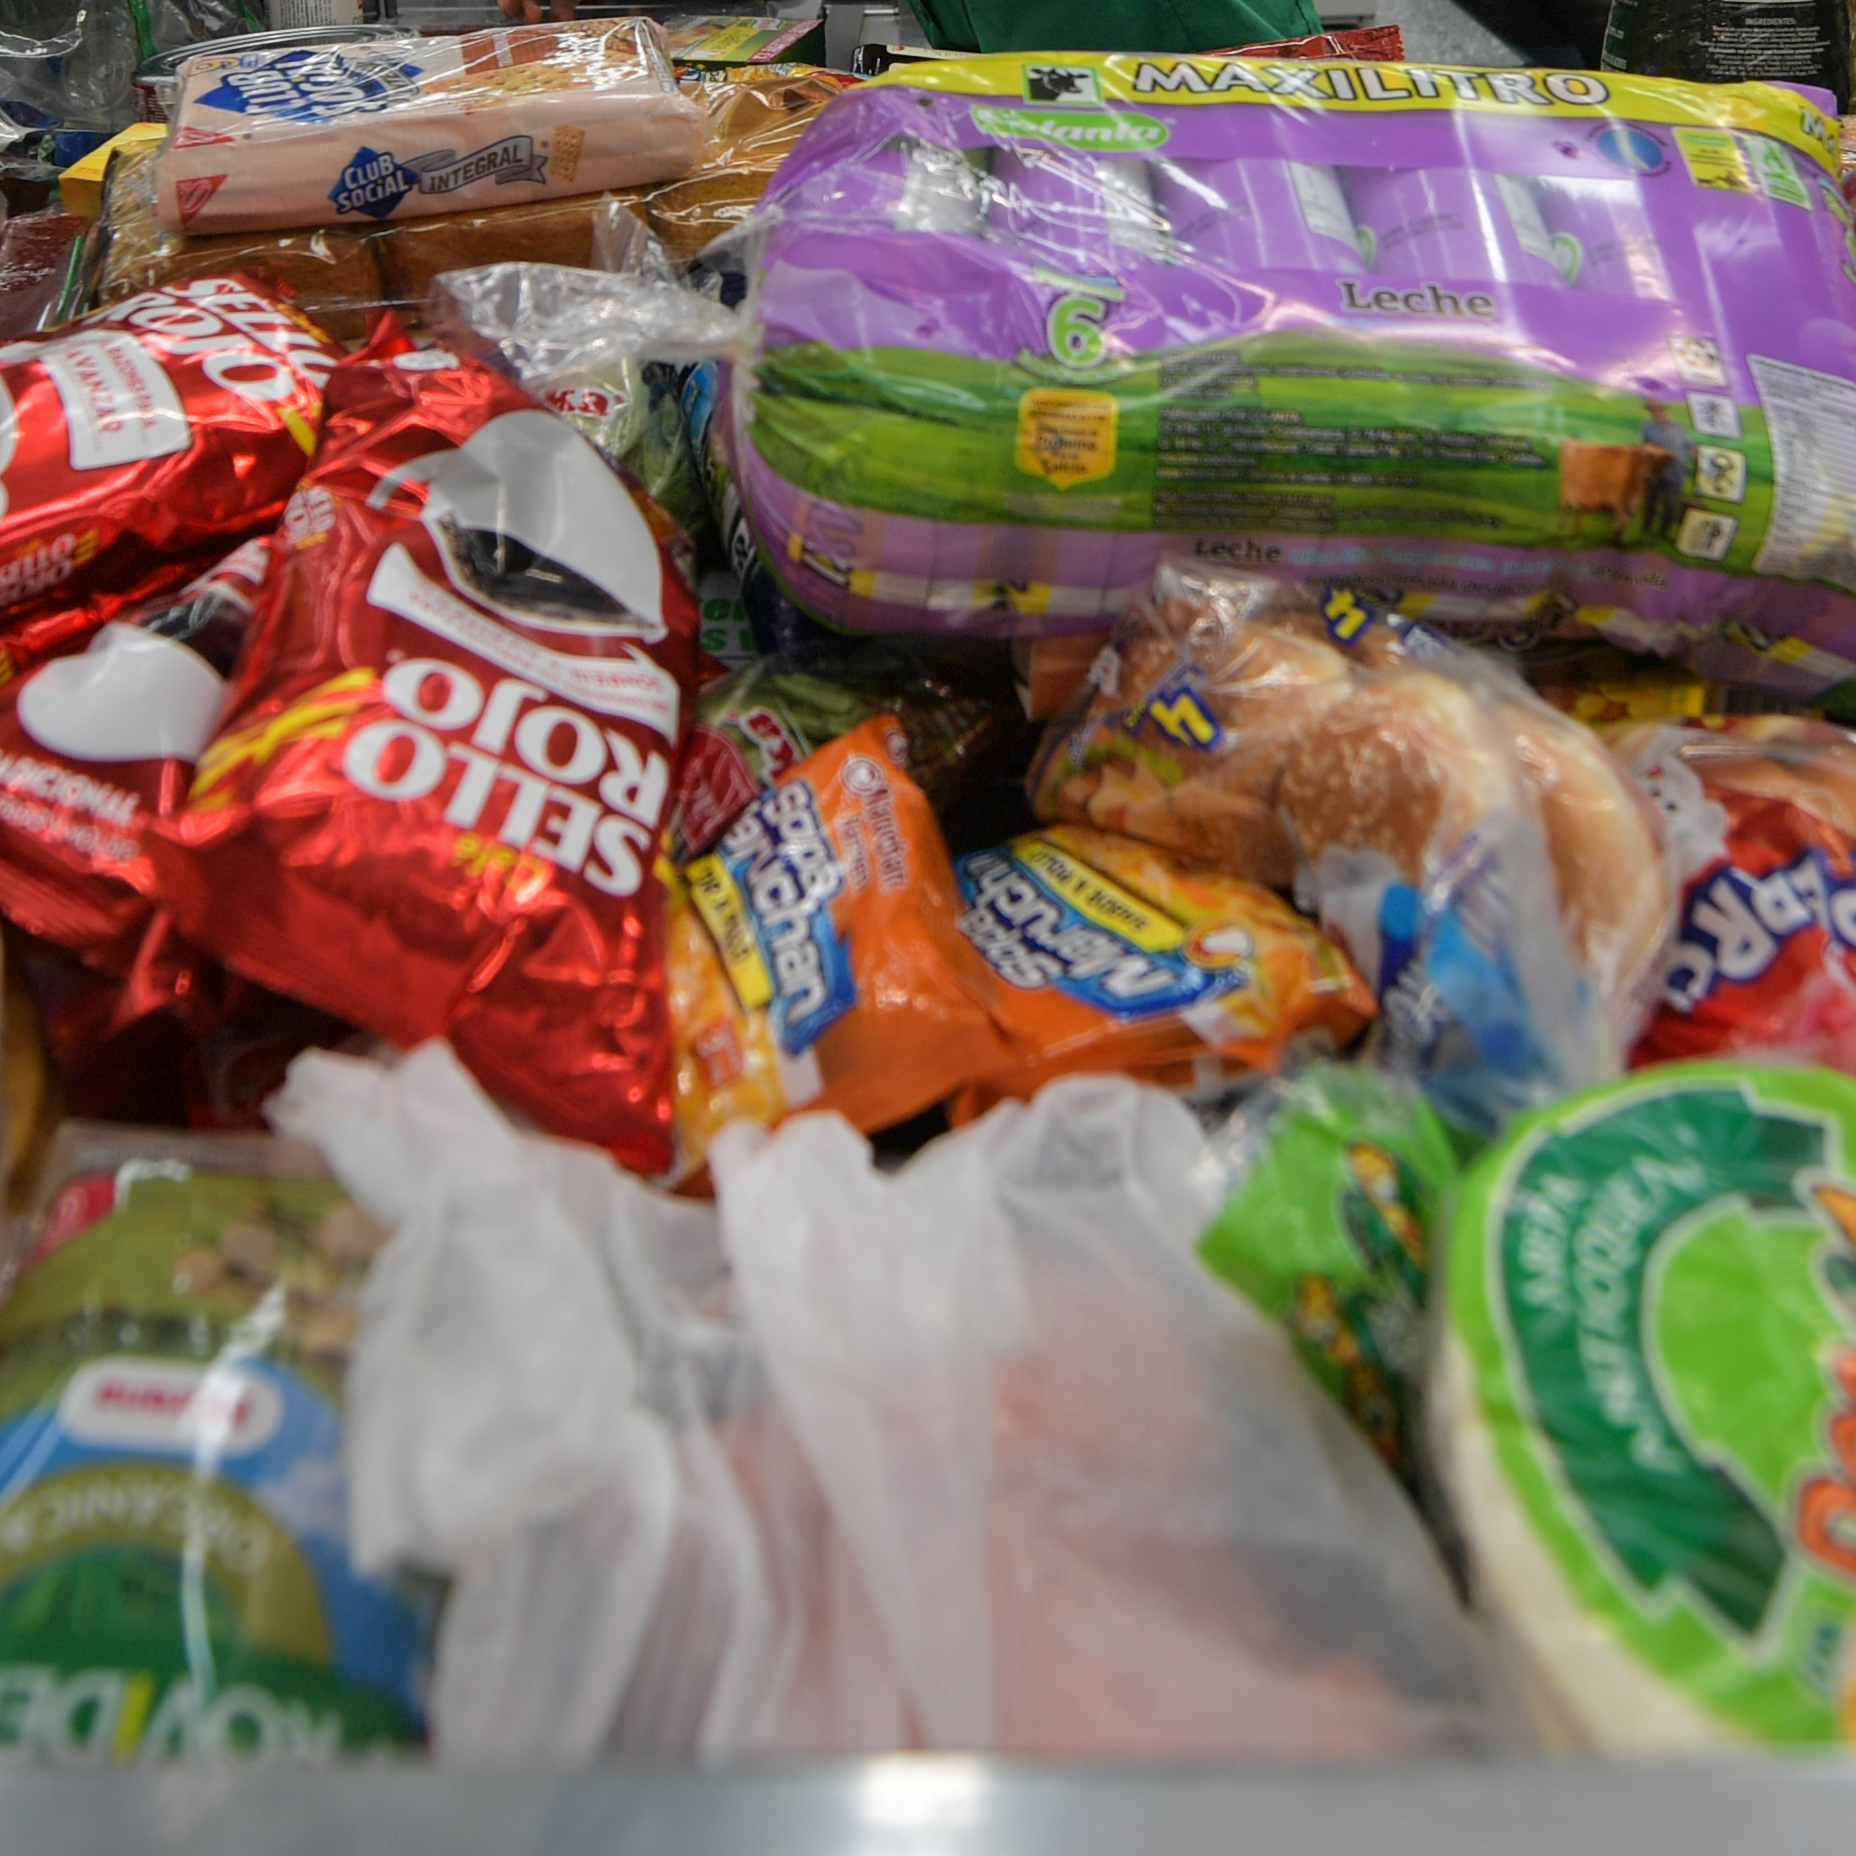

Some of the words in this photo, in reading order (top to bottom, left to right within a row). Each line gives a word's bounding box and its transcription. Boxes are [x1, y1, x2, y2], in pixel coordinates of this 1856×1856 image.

[1133, 61, 1610, 107] MAXILITRO
[343, 152, 393, 190] CLUB
[426, 140, 527, 195] INTEGRAL
[166, 277, 342, 389] SELLO
[1049, 290, 1108, 370] 6
[1339, 281, 1496, 318] Leche
[66, 350, 123, 446] AVANZAR
[1194, 537, 1282, 564] Leche
[383, 657, 668, 829] ROJO
[343, 718, 650, 897] SELLO
[762, 780, 839, 895] sopa
[724, 812, 832, 1026] aruchan
